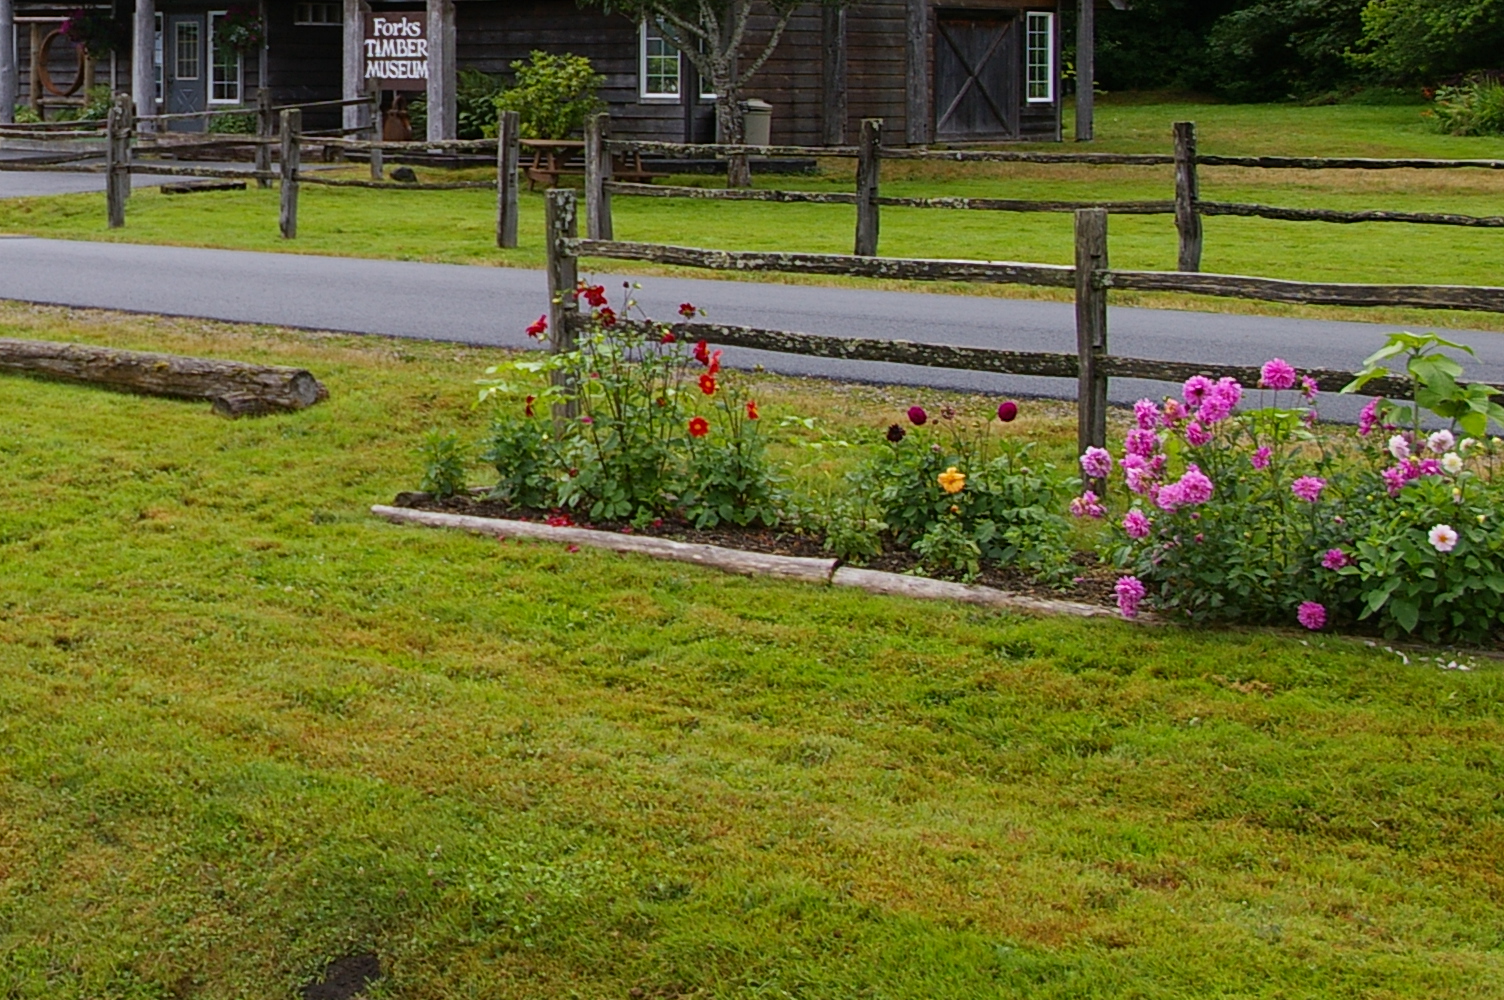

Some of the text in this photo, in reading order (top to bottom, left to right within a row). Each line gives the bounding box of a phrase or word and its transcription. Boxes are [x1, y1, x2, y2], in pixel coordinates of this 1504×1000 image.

[372, 16, 422, 37] Forks
[364, 39, 429, 57] TIMBER
[364, 60, 429, 79] MUSEUM
